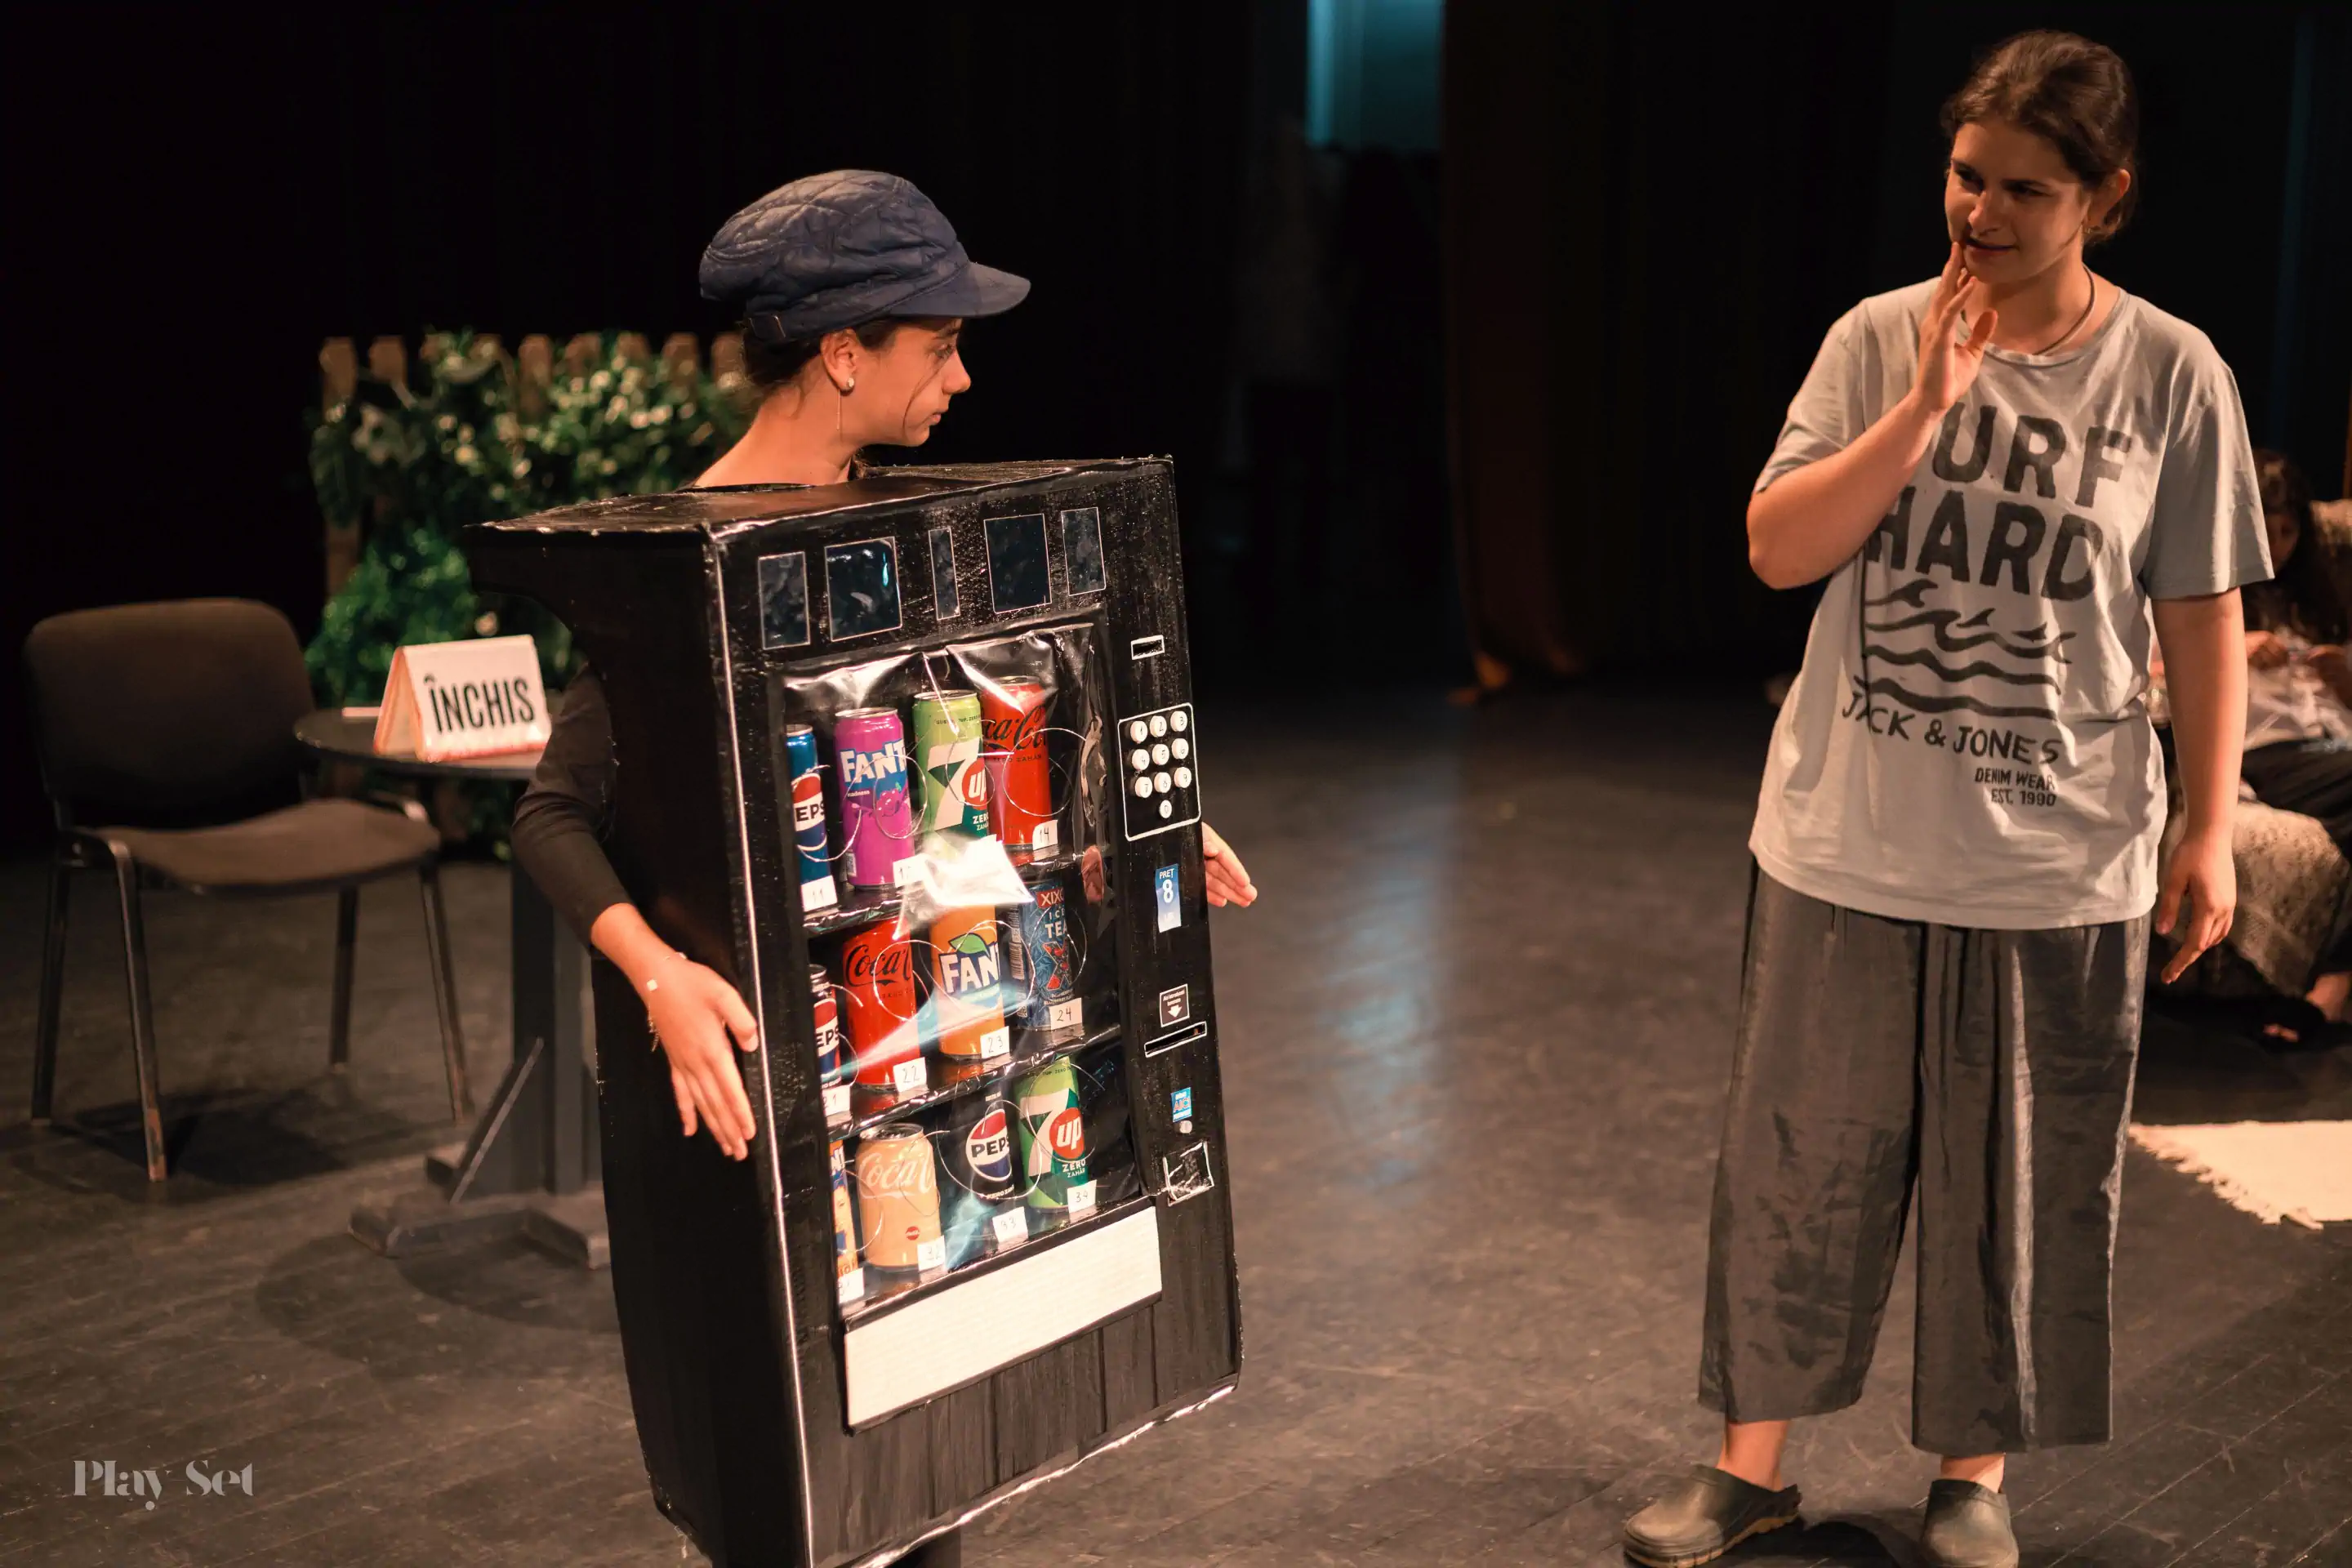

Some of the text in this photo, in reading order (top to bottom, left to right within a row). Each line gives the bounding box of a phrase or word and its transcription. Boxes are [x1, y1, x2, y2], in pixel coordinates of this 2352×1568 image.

[1931, 401, 2132, 508] URF
[1865, 487, 2104, 602] HARD
[423, 673, 536, 733] ÎNCHIS
[1924, 718, 1946, 748] &
[1953, 724, 2063, 765] JONES
[840, 738, 907, 783] FANT
[1974, 766, 2056, 791] DENIM WEAR
[2020, 791, 2056, 807] 1990
[1040, 827, 1049, 840] 14
[1162, 879, 1174, 903] 8
[1056, 1006, 1072, 1022] 24
[987, 1035, 1004, 1054] 23
[902, 1065, 920, 1084] 22
[1076, 1189, 1089, 1203] 34
